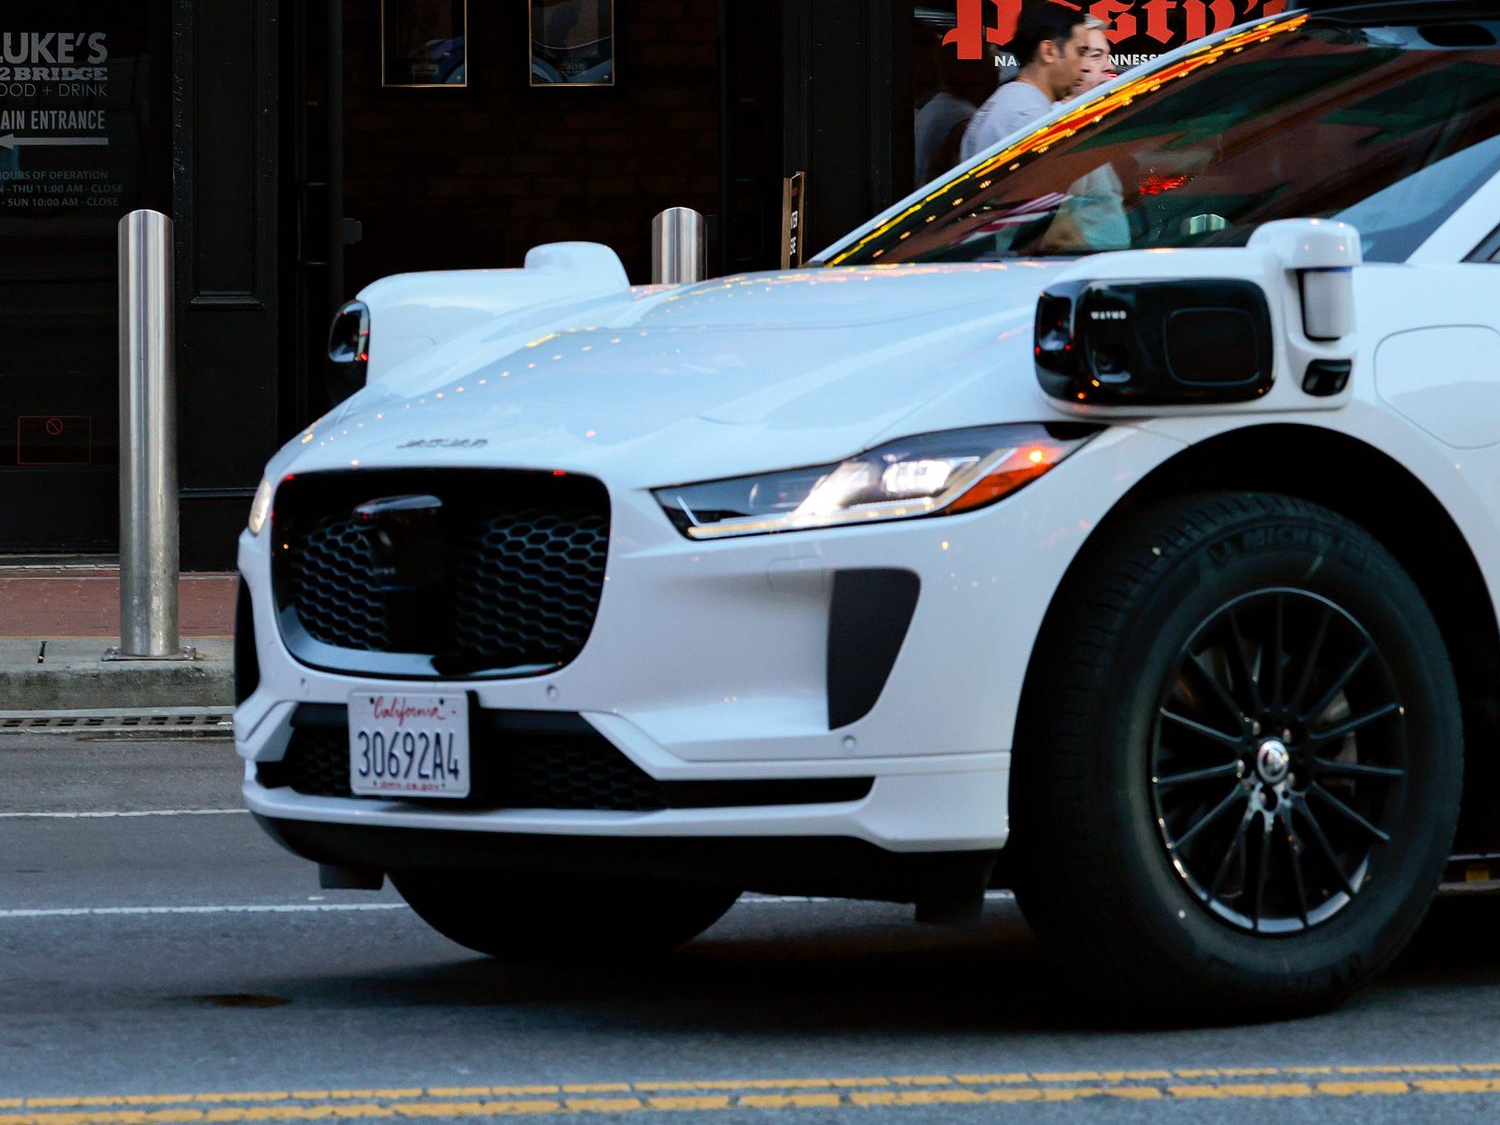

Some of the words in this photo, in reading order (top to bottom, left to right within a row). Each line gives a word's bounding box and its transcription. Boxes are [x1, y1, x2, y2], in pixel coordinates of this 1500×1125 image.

[0, 31, 108, 65] UKE'S
[13, 66, 108, 81] BRIDGE
[58, 83, 107, 97] DRINK
[30, 109, 106, 130] ENTRANCE
[0, 170, 30, 180] OURS
[33, 170, 47, 180] OF
[49, 170, 108, 180] OPERATION
[37, 184, 65, 193] 11:00
[66, 184, 82, 193] AM
[90, 183, 124, 193] CLOSE
[8, 197, 29, 207] SUN
[33, 197, 60, 207] 10:00
[61, 197, 79, 207] AM
[87, 197, 120, 207] CLOSE
[1090, 309, 1127, 320] WAYMO
[373, 695, 446, 727] California
[358, 730, 460, 781] 30692A4
